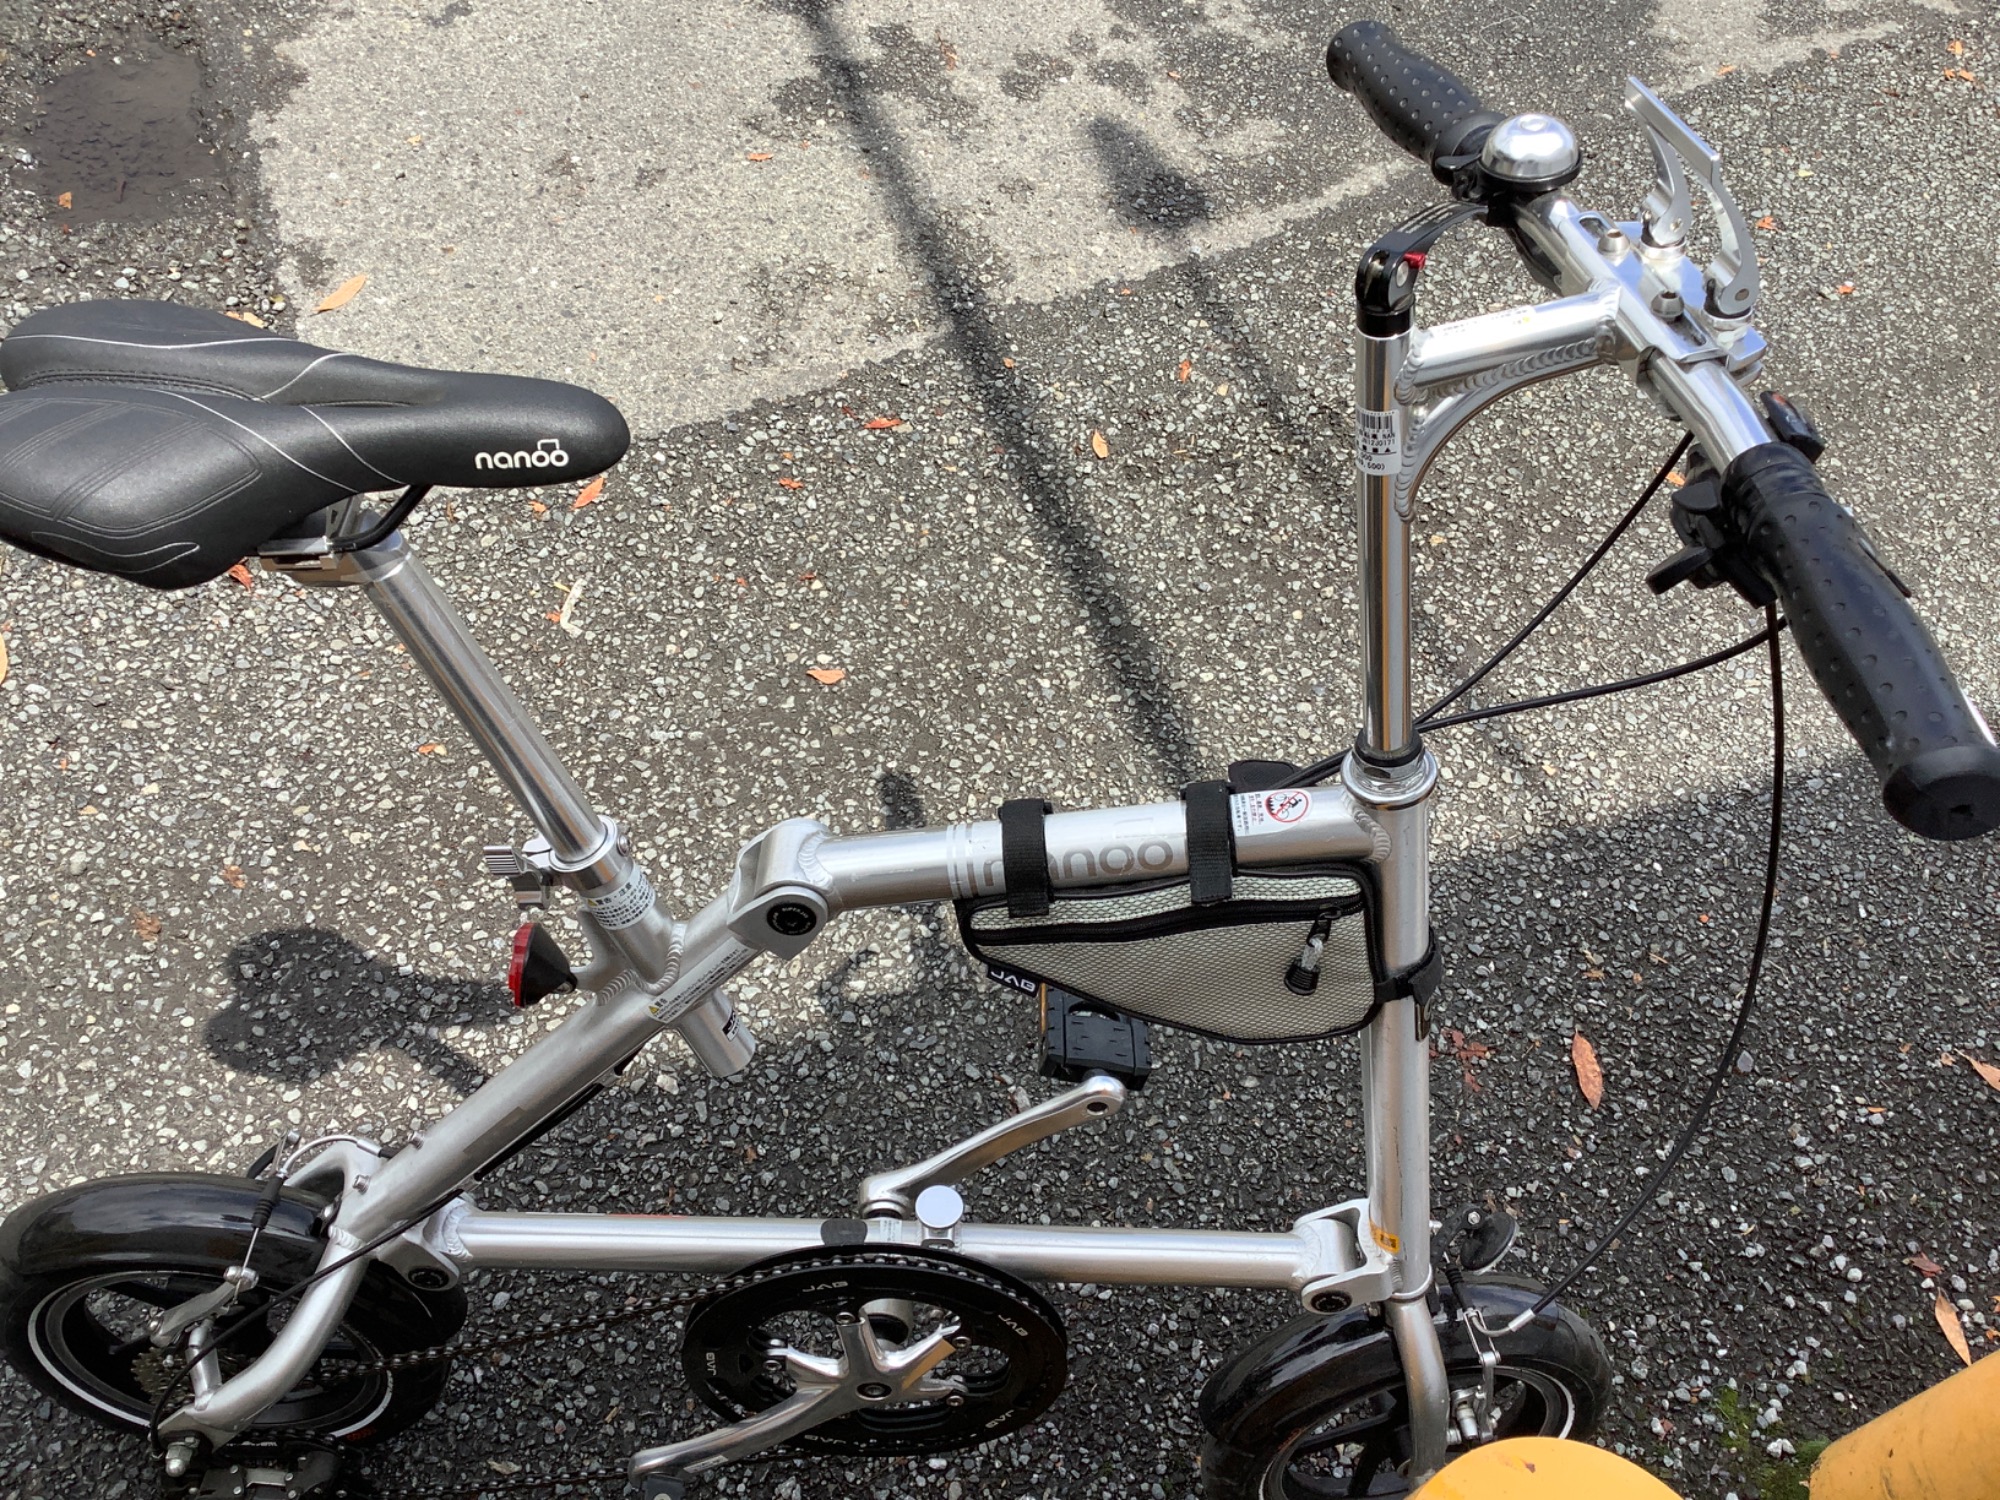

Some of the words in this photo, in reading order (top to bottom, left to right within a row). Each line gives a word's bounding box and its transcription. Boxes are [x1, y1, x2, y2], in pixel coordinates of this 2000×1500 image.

[475, 439, 569, 469] nanoo
[991, 971, 1036, 992] JAB
[802, 1280, 849, 1293] JAB
[998, 1314, 1029, 1337] JAB
[705, 1352, 717, 1376] JAB
